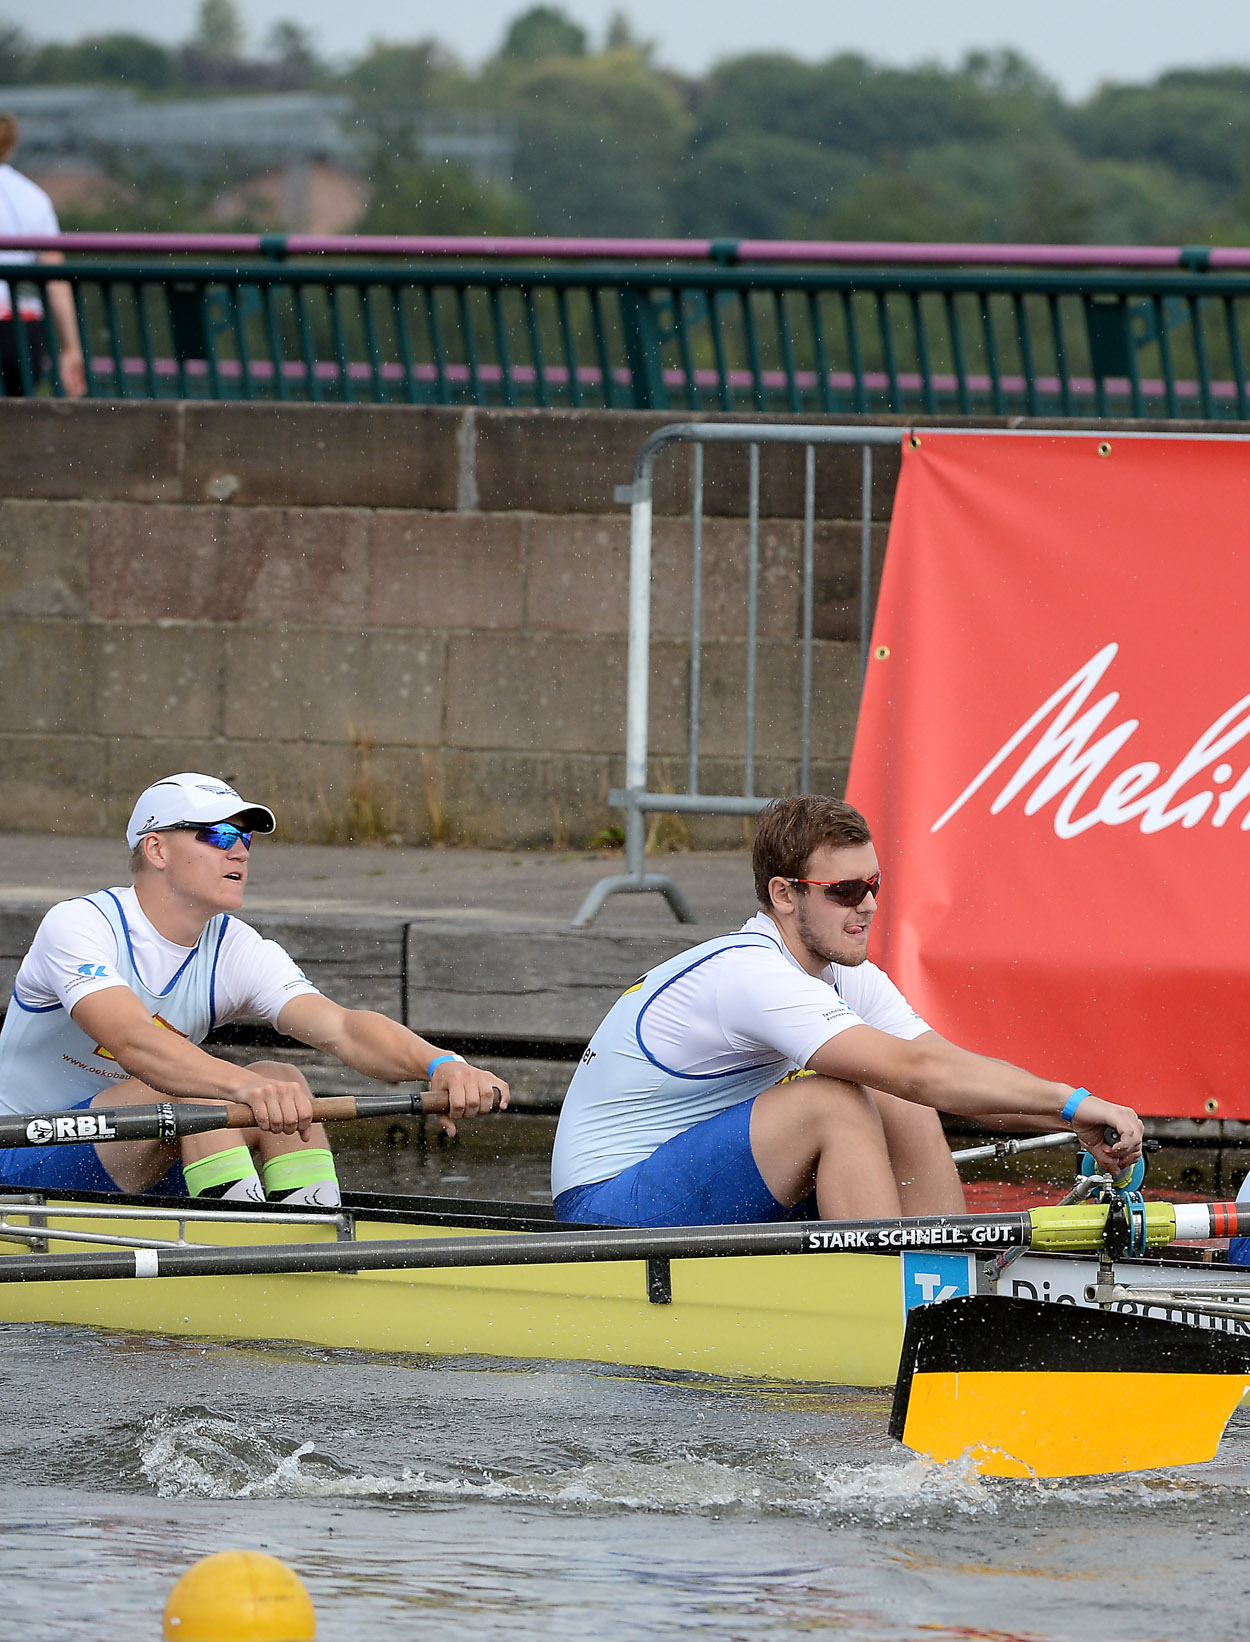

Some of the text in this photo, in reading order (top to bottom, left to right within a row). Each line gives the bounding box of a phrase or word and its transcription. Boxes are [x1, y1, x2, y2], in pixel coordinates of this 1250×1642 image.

[56, 1115, 116, 1138] RBL
[809, 1225, 1015, 1249] STARK. SCHNELL. GUT.
